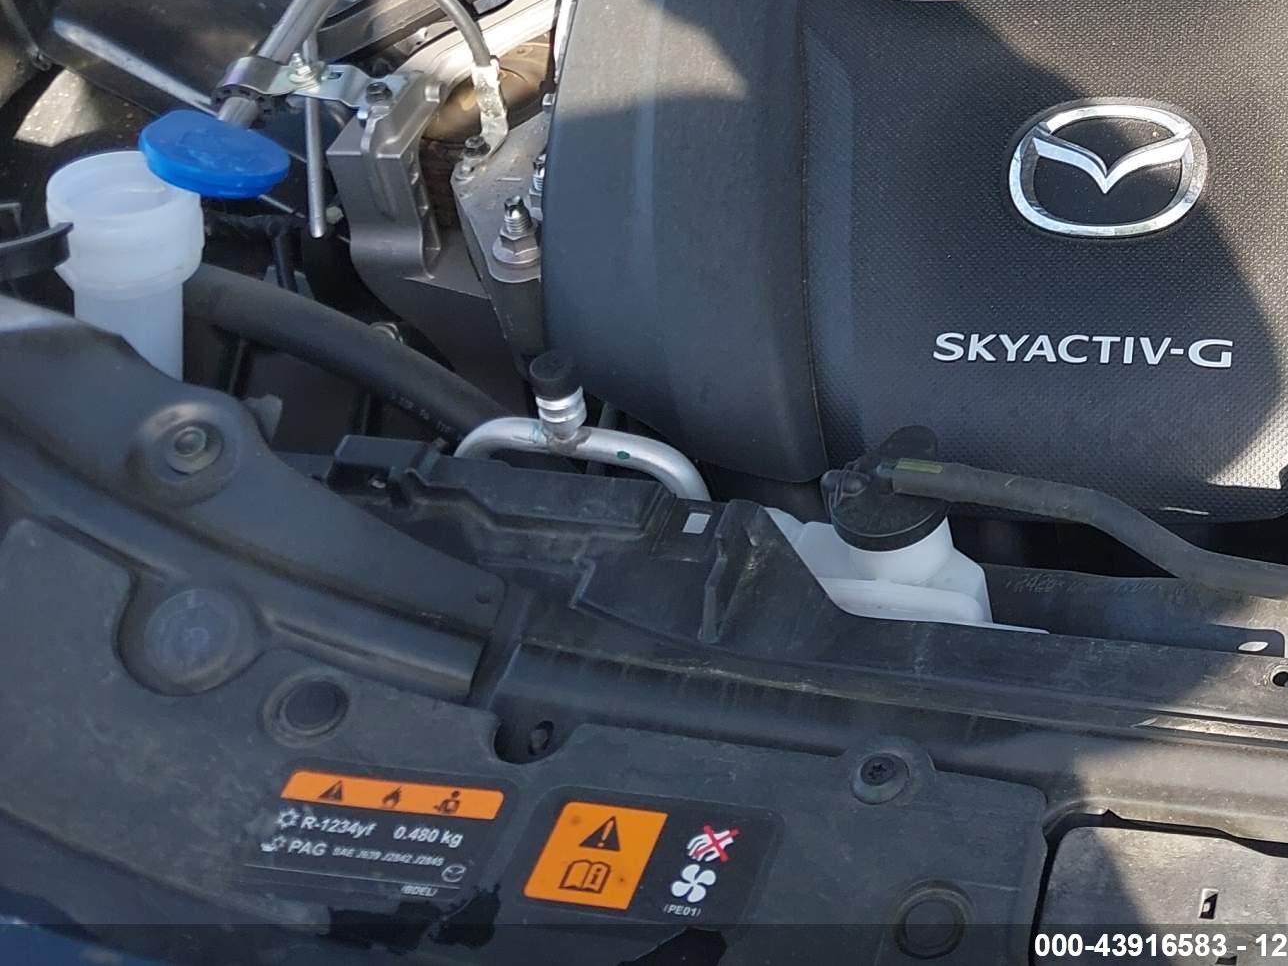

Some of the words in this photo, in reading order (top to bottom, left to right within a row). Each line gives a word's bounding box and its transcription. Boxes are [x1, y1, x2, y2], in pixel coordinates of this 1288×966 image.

[932, 332, 1234, 368] SKYACTIV-G
[287, 839, 328, 857] PAG
[300, 815, 377, 839] R-1234yf
[393, 825, 439, 844] 0.480
[440, 830, 464, 848] kg
